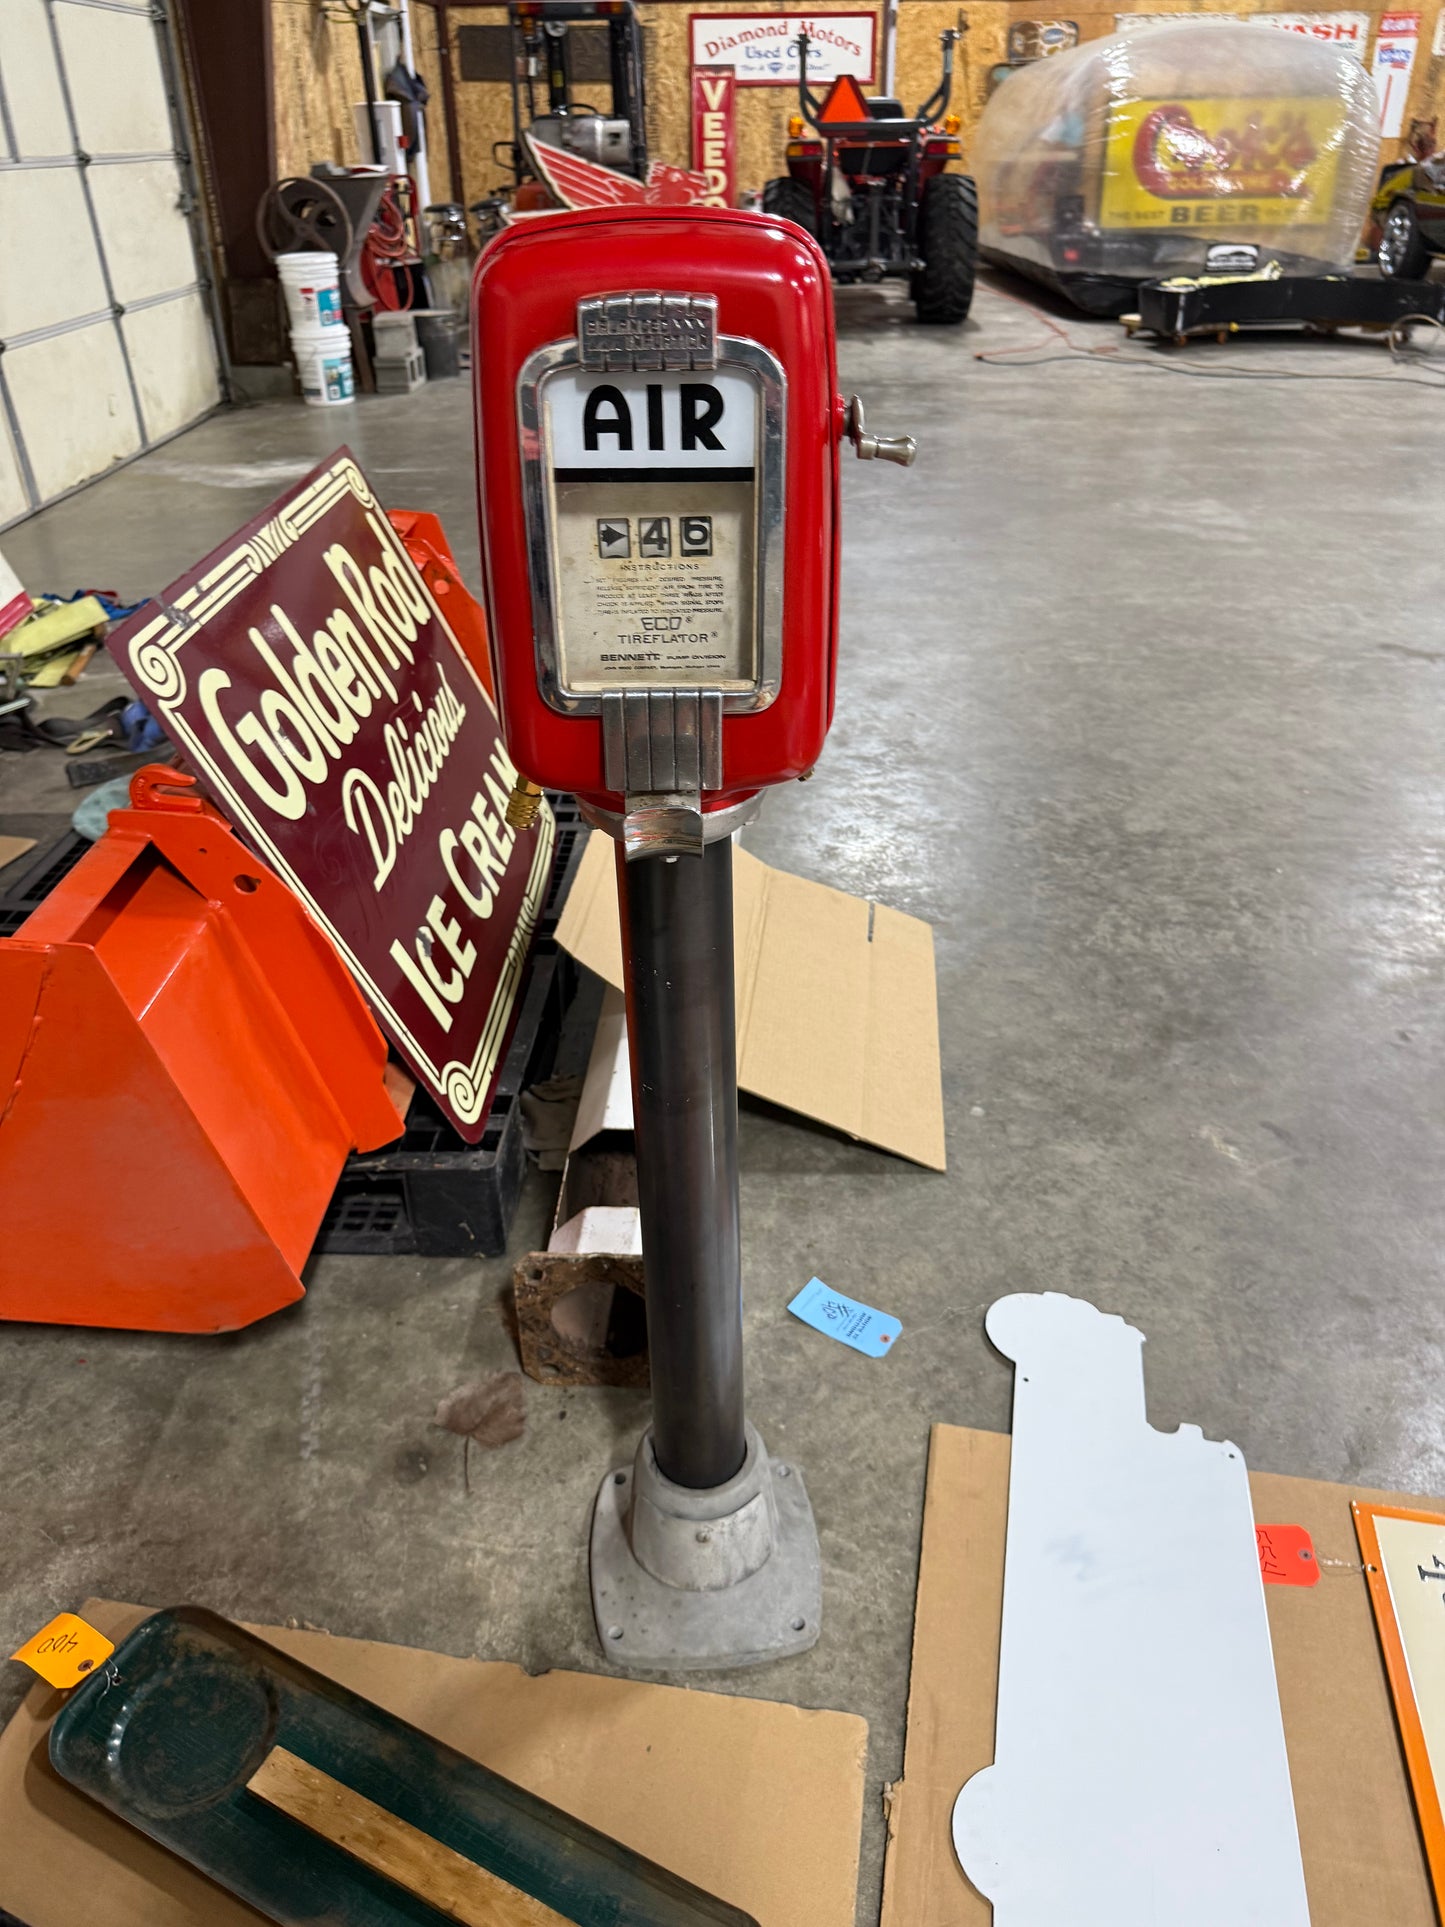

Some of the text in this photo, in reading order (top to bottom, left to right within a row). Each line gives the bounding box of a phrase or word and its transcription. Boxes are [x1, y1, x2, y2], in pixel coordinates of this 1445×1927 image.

[704, 20, 862, 58] Diamond Motors
[745, 44, 822, 59] Used Crs
[1170, 204, 1261, 223] BEER
[583, 383, 727, 451] AIR
[620, 563, 700, 572] INSTRUCTIONS
[641, 616, 683, 631] ECO
[617, 633, 709, 644] TIREFLATOR
[198, 512, 431, 821] Golden Rod
[600, 653, 661, 662] BENNETT
[342, 661, 467, 893] Delicious
[389, 737, 520, 1033] ICE CREAM
[37, 1632, 78, 1654] 400
